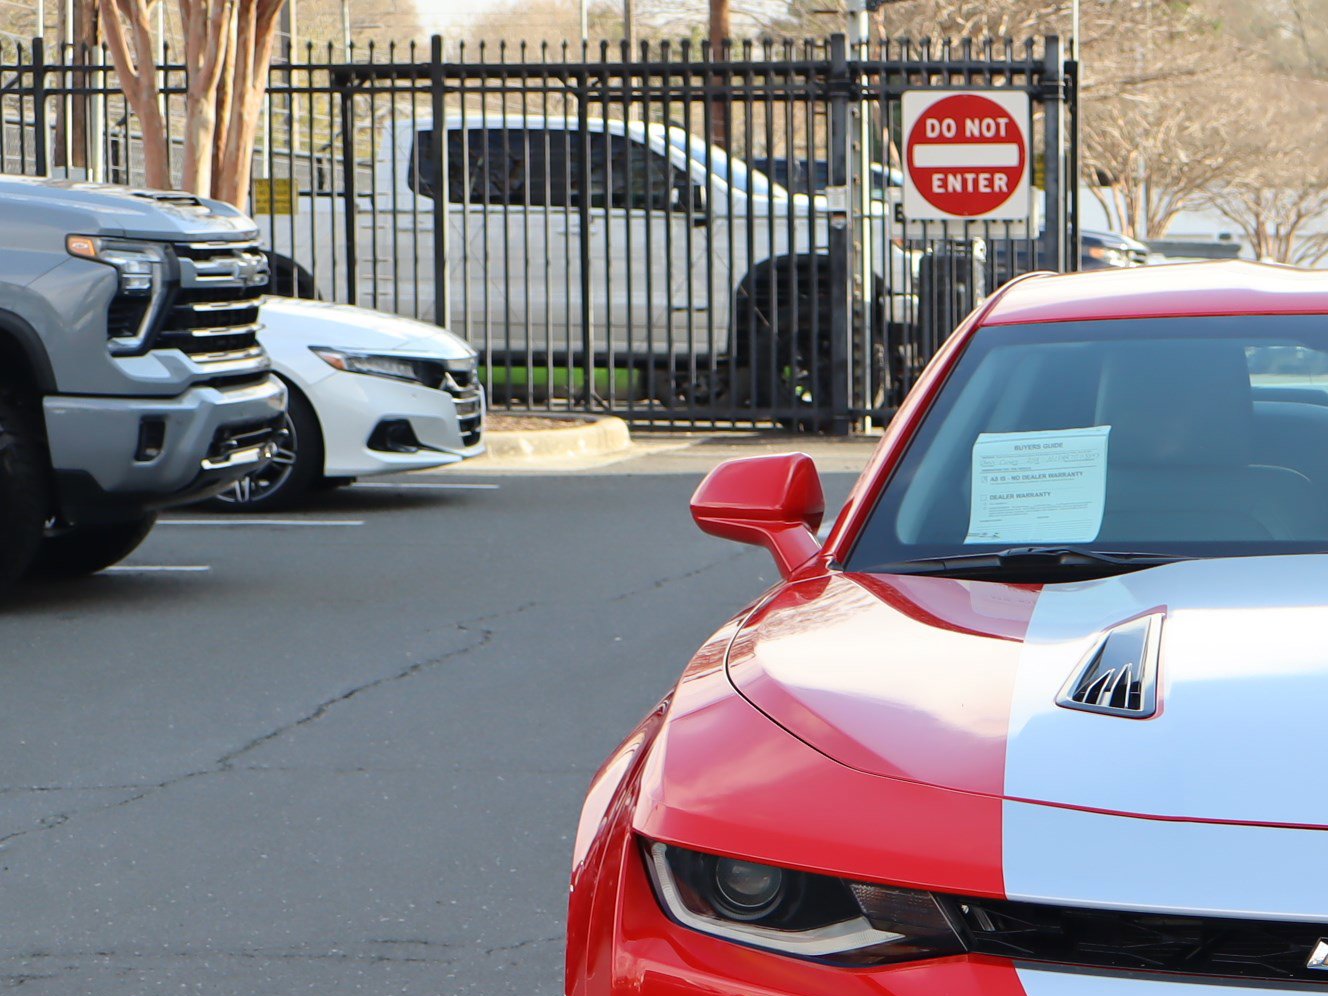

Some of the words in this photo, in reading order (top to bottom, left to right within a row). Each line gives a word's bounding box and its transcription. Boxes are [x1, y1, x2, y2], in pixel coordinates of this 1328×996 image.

[925, 117, 957, 138] DO
[965, 117, 1009, 138] NOT
[931, 173, 1009, 193] ENTER
[1014, 443, 1041, 451] BUYERS
[1048, 471, 1083, 479] WARRANTY
[1016, 491, 1051, 499] WARRANTY
